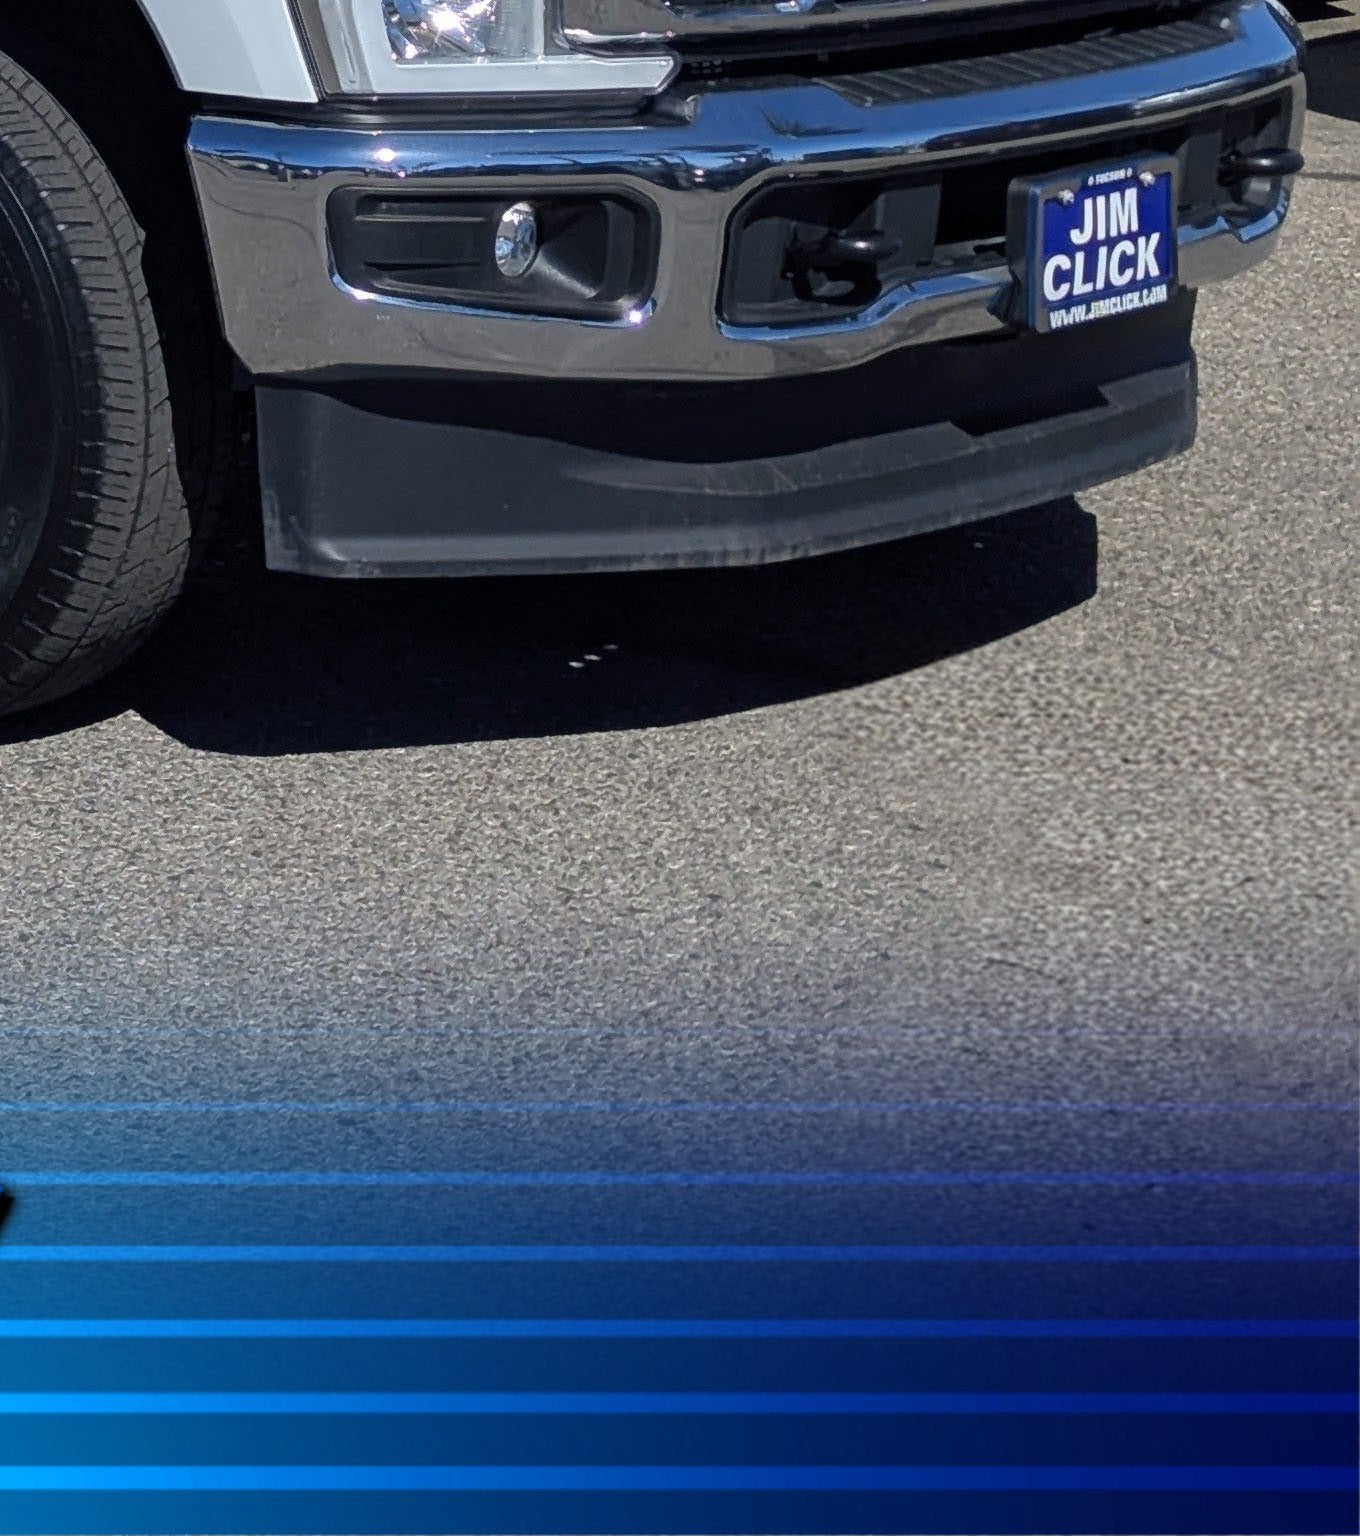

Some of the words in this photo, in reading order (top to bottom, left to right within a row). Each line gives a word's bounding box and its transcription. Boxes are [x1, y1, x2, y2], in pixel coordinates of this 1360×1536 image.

[1069, 186, 1139, 246] JIM
[1042, 231, 1162, 302] CLICK
[1049, 283, 1168, 330] WWW.JIMCLICK.COM
